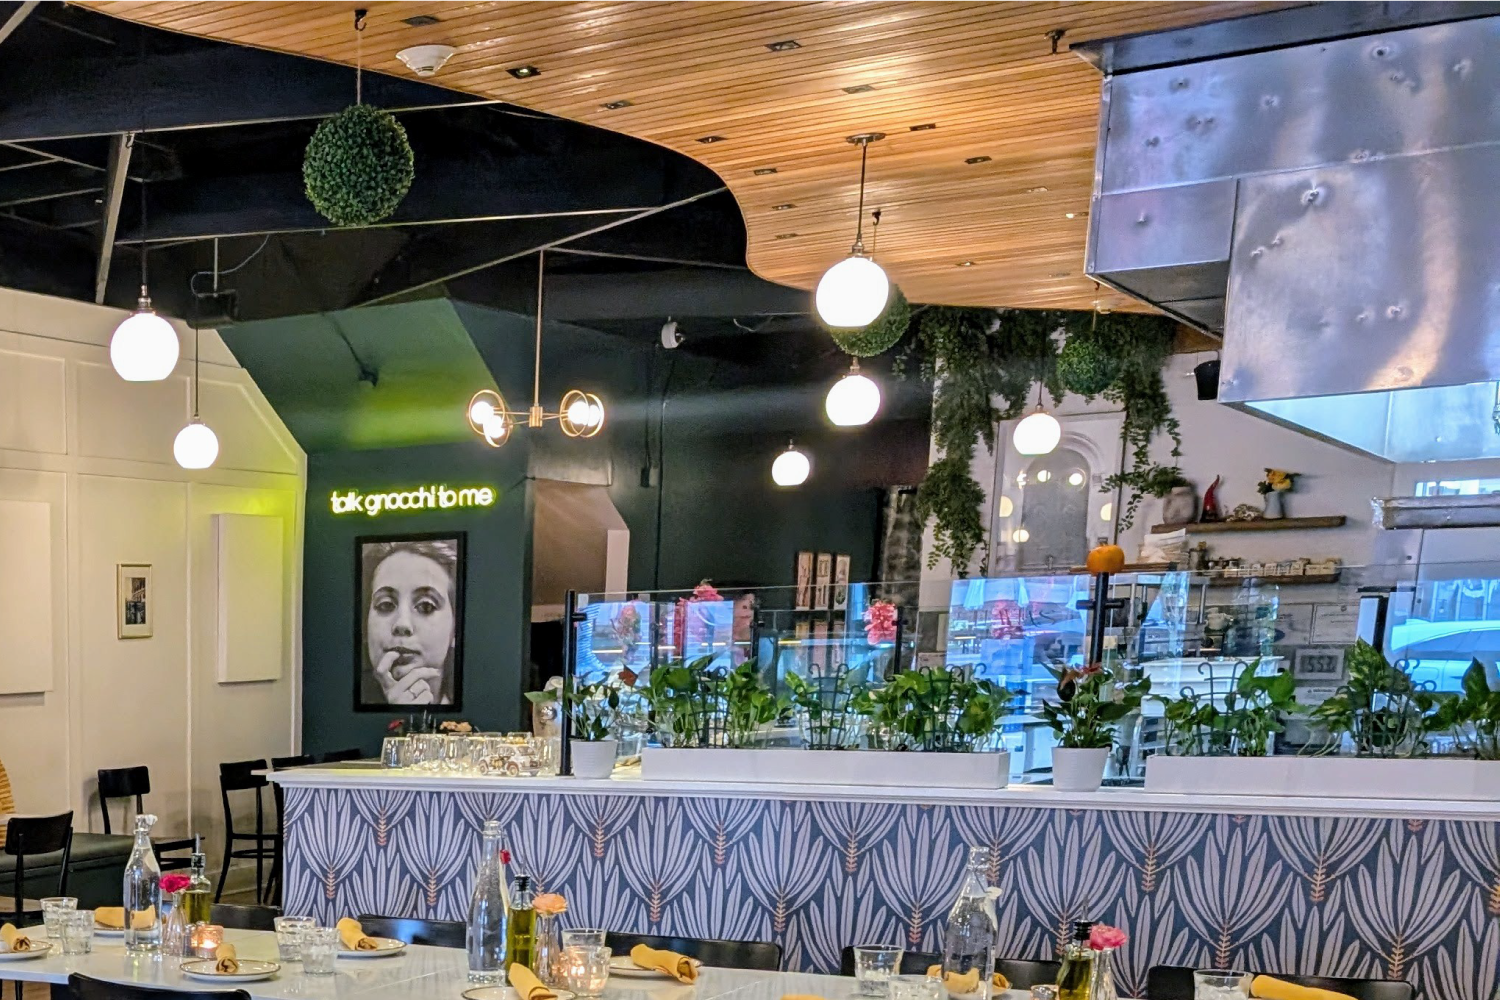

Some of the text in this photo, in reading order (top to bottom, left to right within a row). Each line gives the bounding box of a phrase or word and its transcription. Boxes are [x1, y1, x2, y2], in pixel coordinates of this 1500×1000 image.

[330, 485, 494, 516] talk gnocchi to me
